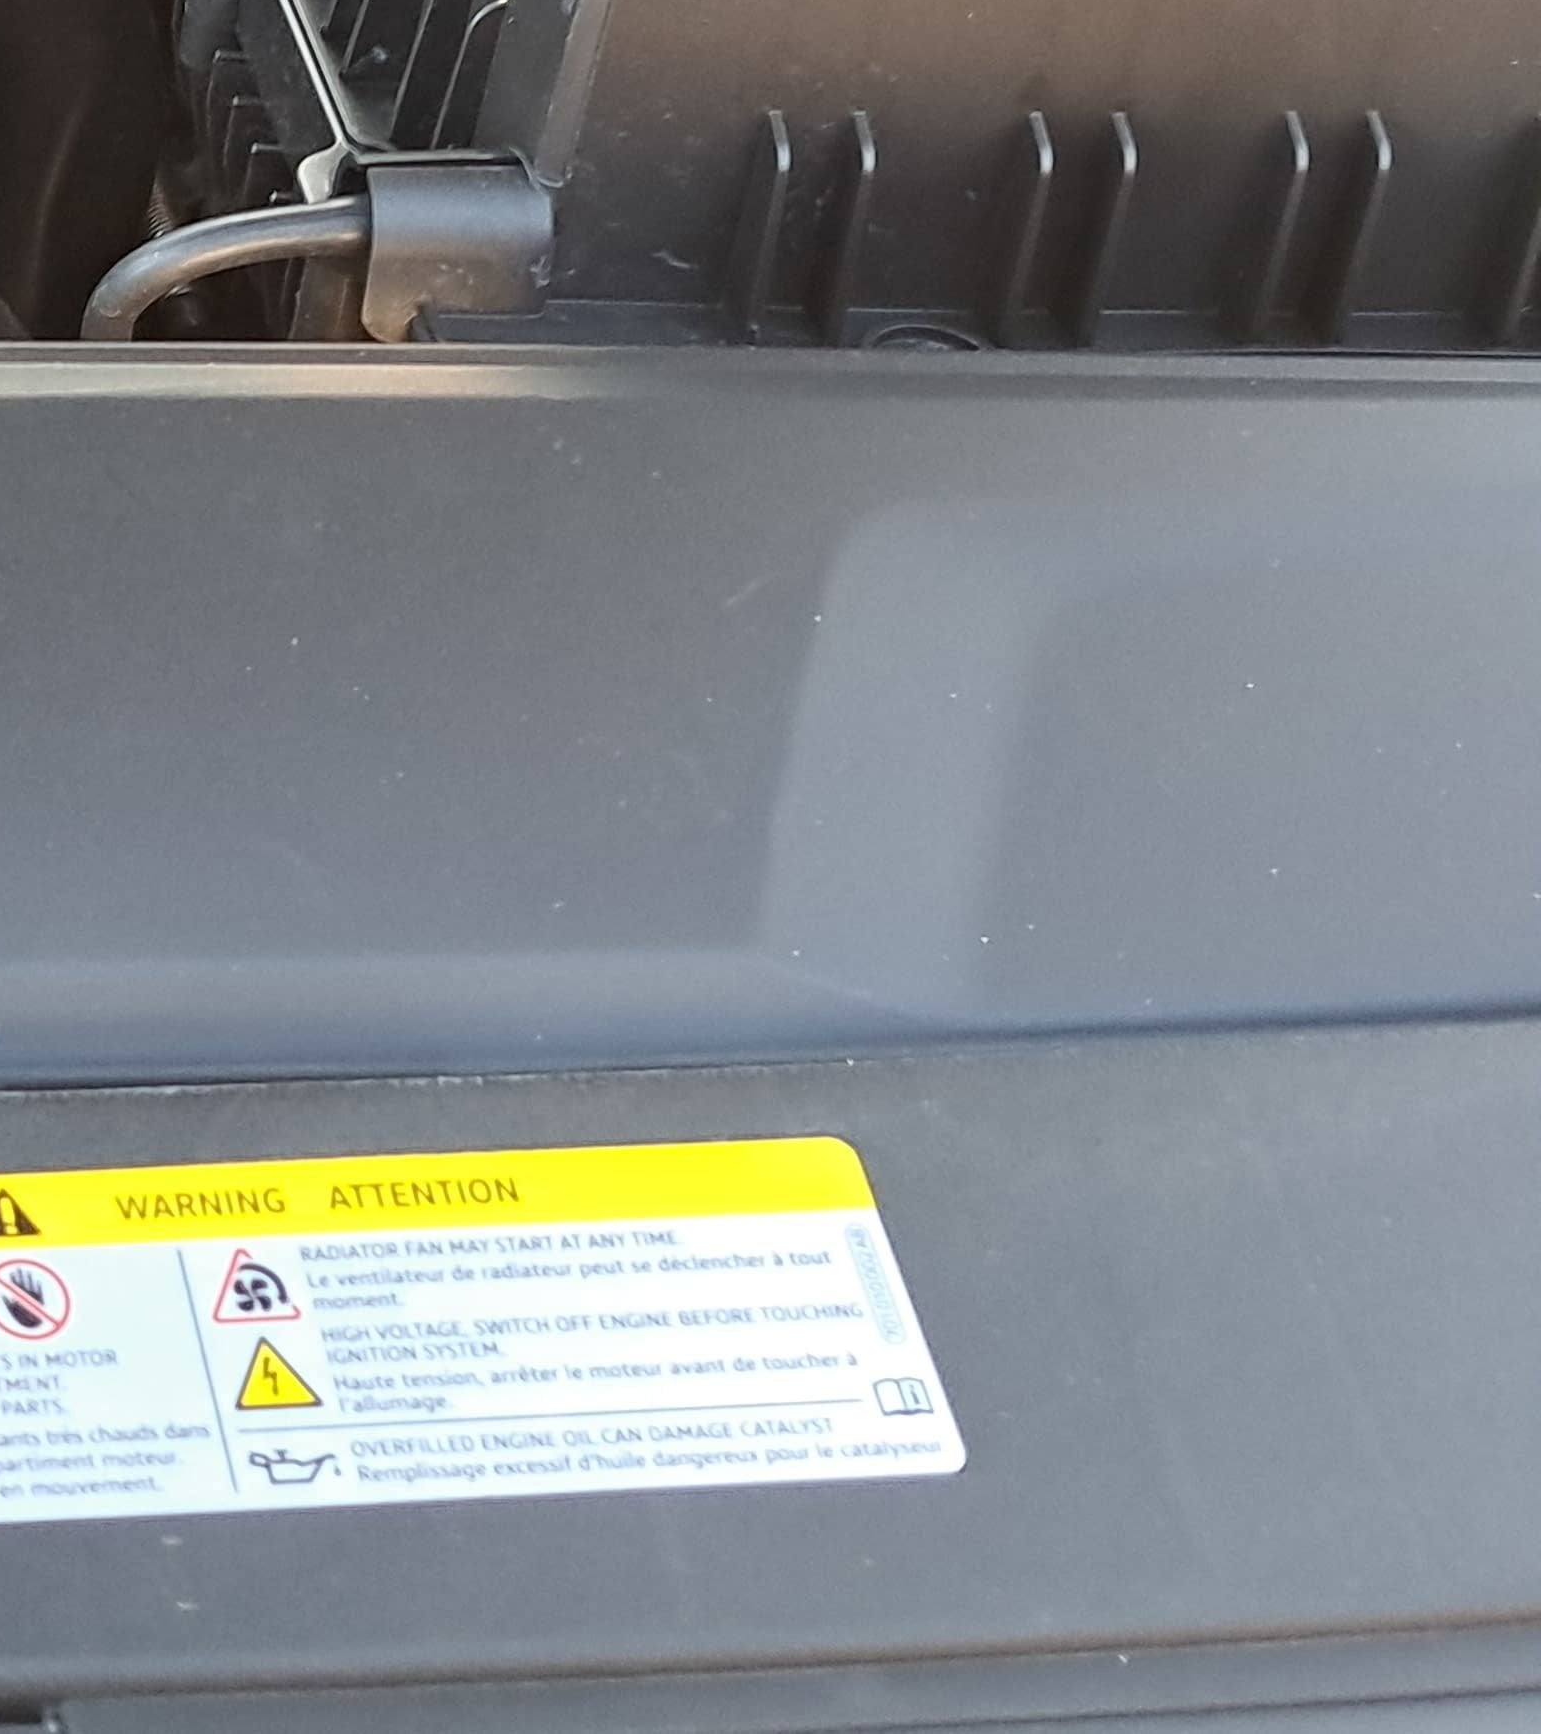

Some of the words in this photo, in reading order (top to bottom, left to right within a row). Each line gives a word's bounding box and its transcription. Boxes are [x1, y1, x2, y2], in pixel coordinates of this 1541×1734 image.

[116, 1188, 287, 1221] WARNING
[328, 1177, 521, 1211] ATTENTION
[300, 1242, 399, 1262] RADIATOR
[404, 1241, 444, 1257] FAN
[449, 1239, 489, 1255] MAY
[495, 1236, 553, 1254] START
[560, 1234, 582, 1250] AT
[588, 1232, 626, 1250] ANY
[305, 1272, 331, 1290] Le
[336, 1267, 445, 1287] ventilateur
[451, 1265, 477, 1283] de
[482, 1262, 573, 1280] radiateur
[579, 1258, 623, 1280] peut
[631, 1258, 653, 1274] se
[657, 1253, 766, 1273] déclencher
[771, 1251, 785, 1268] à
[789, 1249, 832, 1267] tout
[321, 1325, 371, 1344] HIGH
[474, 1317, 550, 1336] SWITCH
[555, 1314, 592, 1332] OFF
[599, 1310, 674, 1330] ENGINE
[679, 1306, 757, 1326] BEFORE
[761, 1301, 865, 1322] TOUCHING
[19, 1352, 39, 1368] IN
[46, 1348, 118, 1367] MOTOR
[327, 1346, 417, 1365] IGNITION
[332, 1372, 397, 1392] Haute
[490, 1362, 559, 1384] arrêter
[564, 1362, 583, 1381] le
[588, 1360, 663, 1380] moteur
[669, 1357, 727, 1376] avant
[732, 1356, 758, 1374] de
[762, 1353, 837, 1372] toucher
[845, 1351, 859, 1367] à
[47, 1428, 83, 1446] très
[89, 1424, 158, 1444] chauds
[163, 1422, 211, 1441] dans
[349, 1433, 476, 1458] OVERFILLED
[480, 1431, 555, 1451] ENGINE
[561, 1429, 595, 1447] OIL
[600, 1424, 643, 1445] CAN
[647, 1421, 733, 1442] DAMAGE
[739, 1417, 835, 1438] CATALYST
[357, 1461, 487, 1485] Remplissage
[492, 1457, 574, 1477] excessif
[579, 1450, 647, 1472] d'huile
[651, 1448, 759, 1470] dangereux
[765, 1446, 812, 1466] pour
[816, 1443, 835, 1460] le
[839, 1439, 943, 1458] catalyseur
[0, 1483, 25, 1498] en
